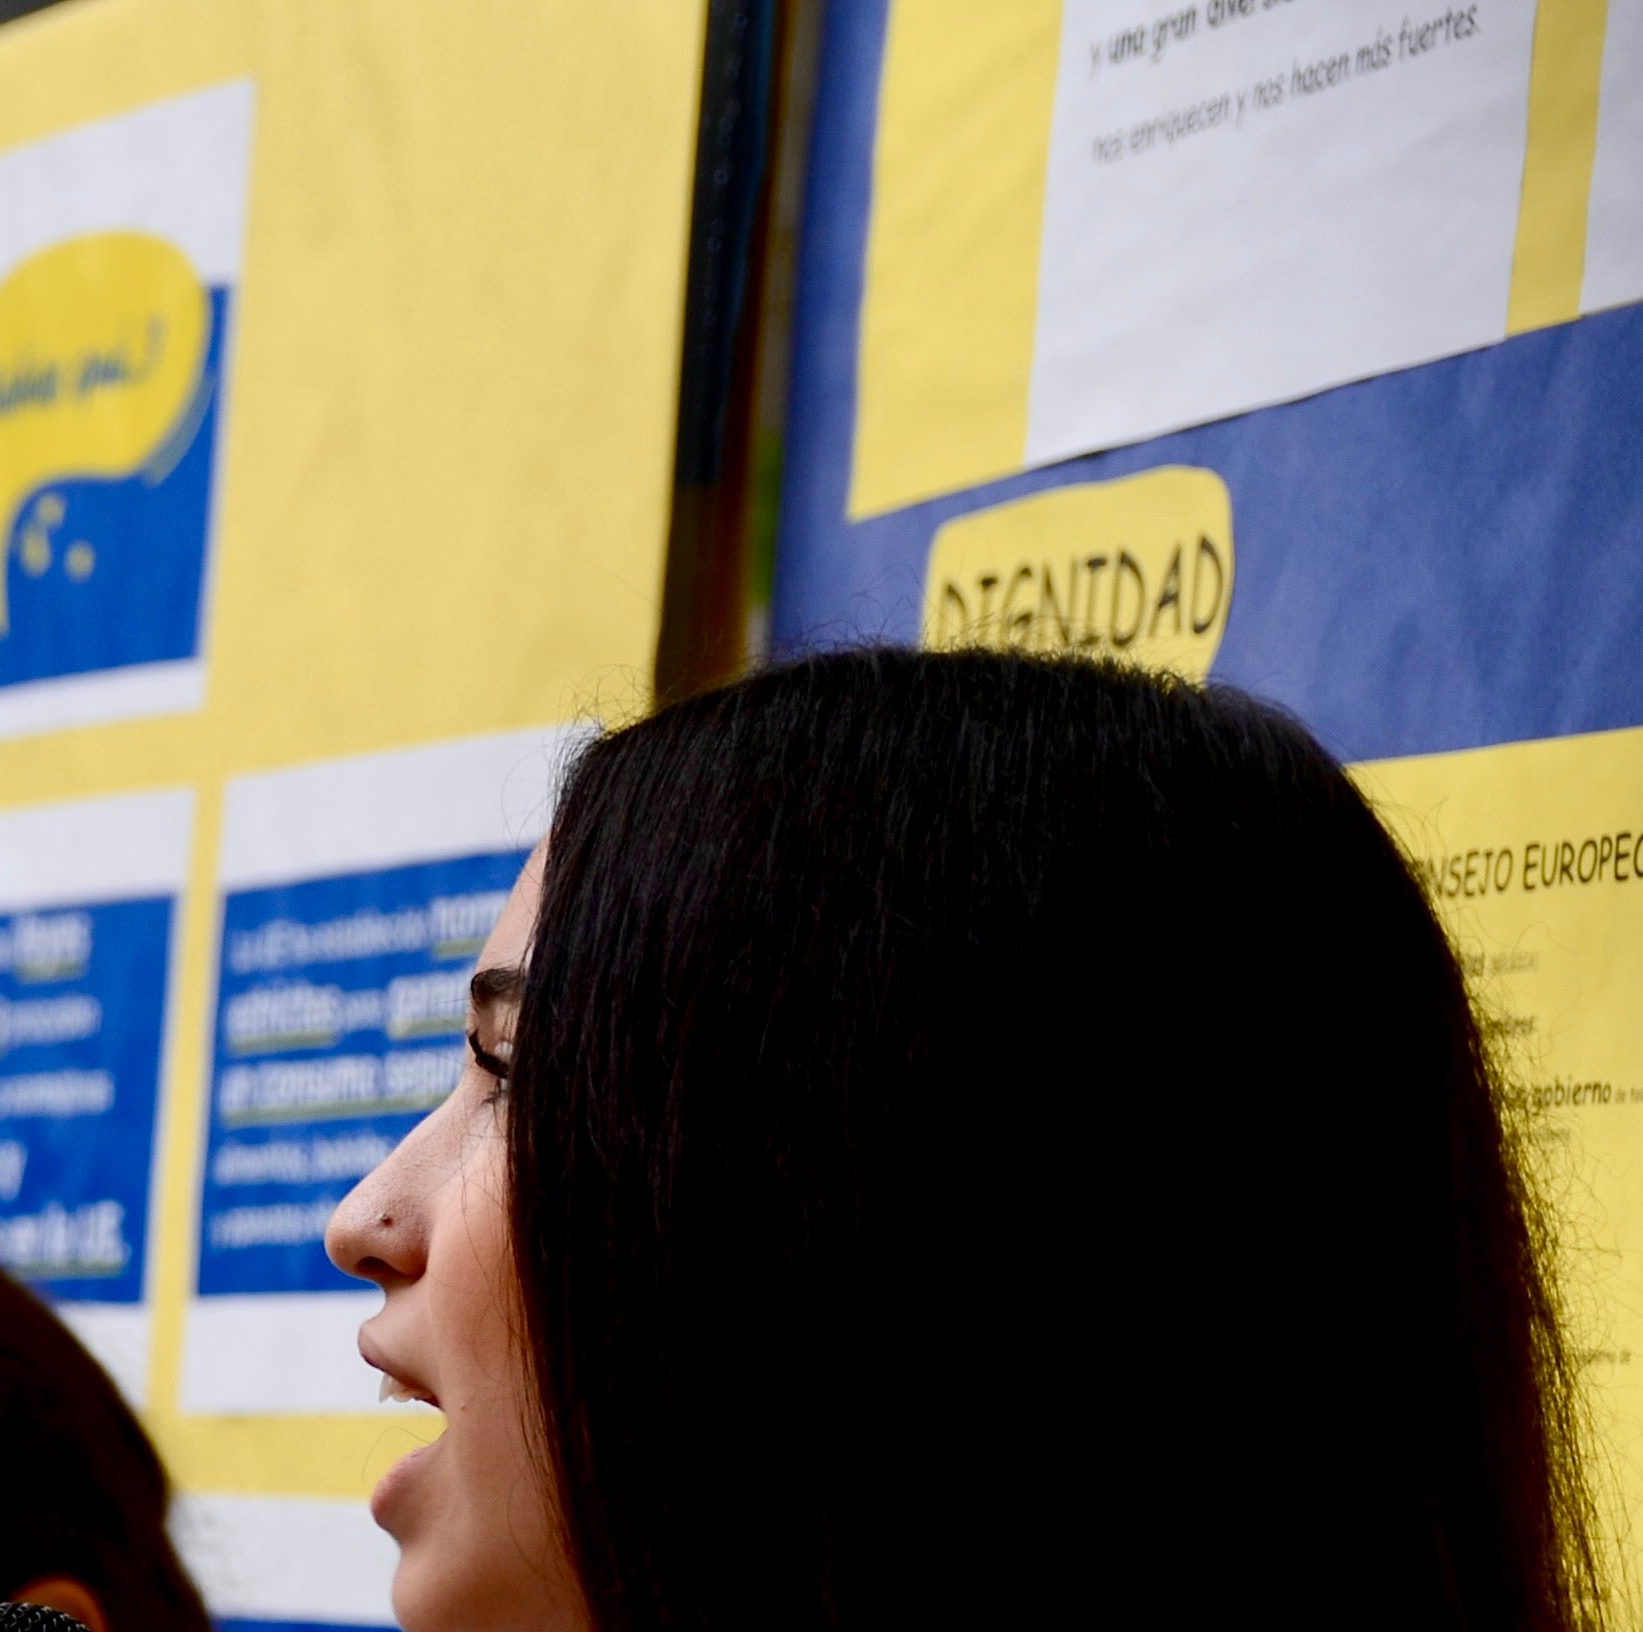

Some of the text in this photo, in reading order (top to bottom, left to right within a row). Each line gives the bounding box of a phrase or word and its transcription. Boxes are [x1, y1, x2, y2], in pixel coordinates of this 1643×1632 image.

[1108, 25, 1146, 64] una
[1151, 6, 1197, 63] gran
[1092, 129, 1124, 162] nos
[1235, 88, 1248, 129] y
[1253, 73, 1285, 109] nos
[1290, 56, 1350, 96] hacen
[1355, 24, 1393, 74] más
[936, 533, 1224, 652] DIGNIDAD
[1413, 847, 1513, 897] NSEJO
[1532, 1073, 1612, 1117] gobierno
